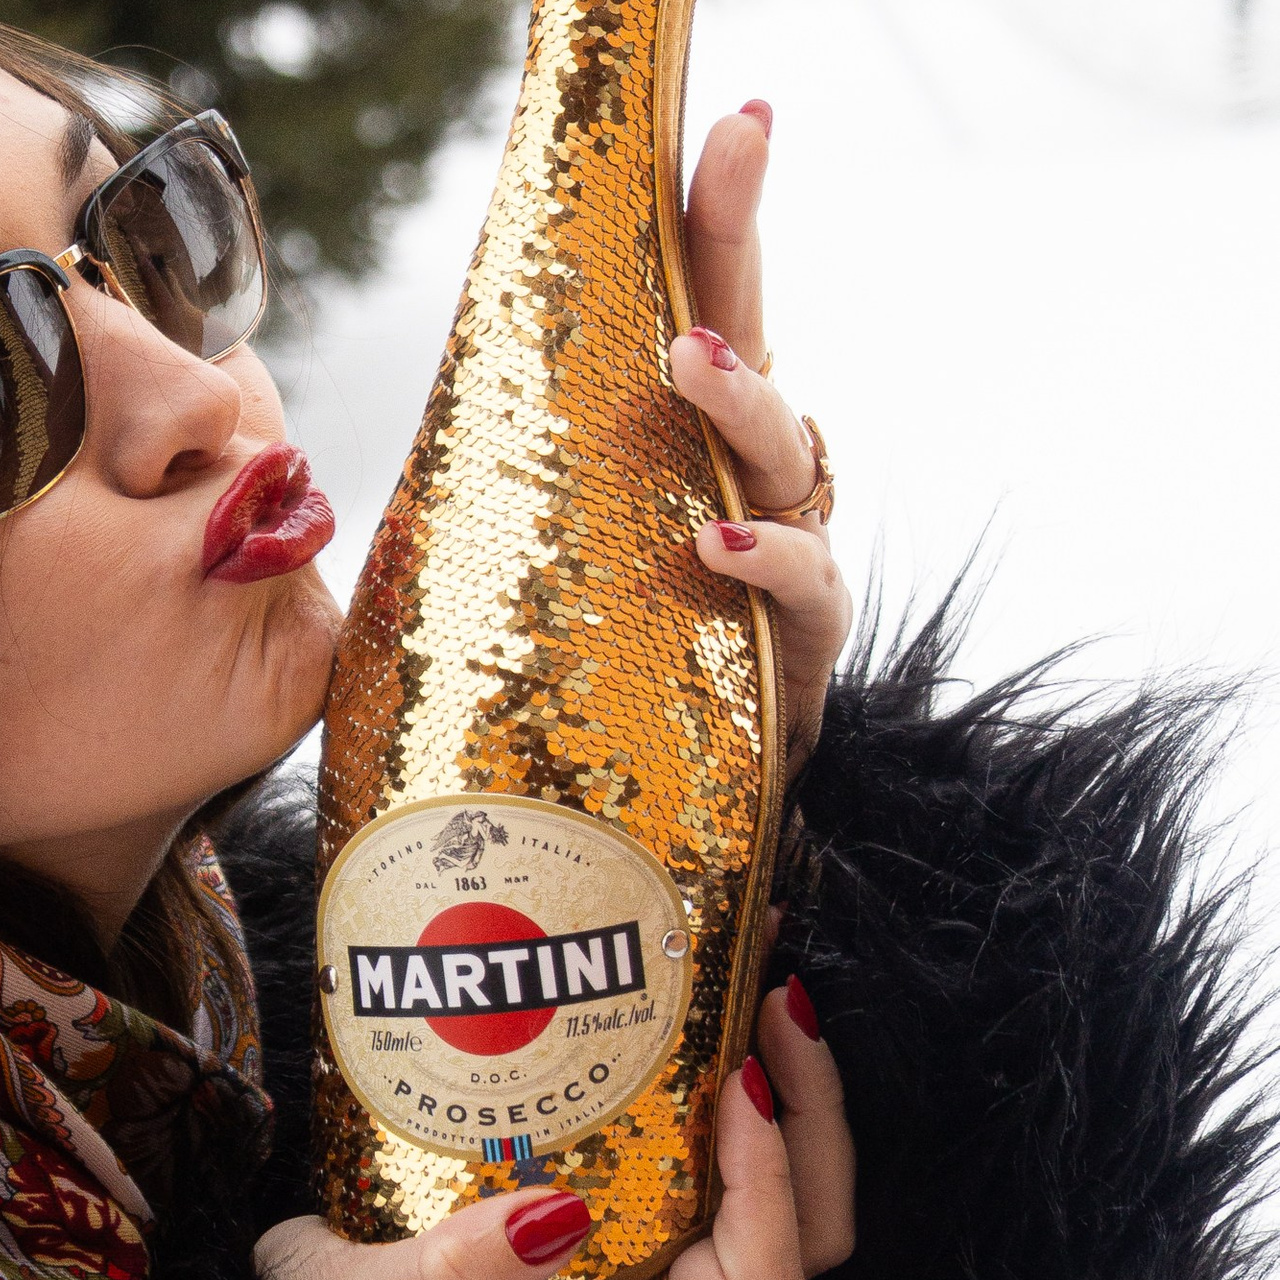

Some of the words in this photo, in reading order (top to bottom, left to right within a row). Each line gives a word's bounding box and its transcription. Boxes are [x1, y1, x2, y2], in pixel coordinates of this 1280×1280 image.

[371, 840, 424, 878] TORINO
[521, 835, 582, 865] ITALIA
[415, 881, 437, 890] DAL
[454, 875, 488, 892] 1863
[357, 932, 633, 1009] MARTINI
[393, 1062, 610, 1127] PROSECCO
[470, 1069, 528, 1085] D.O.C.
[406, 1118, 476, 1145] PRODOTTO
[535, 1127, 551, 1139] IN
[559, 1100, 605, 1131] ITALIA
